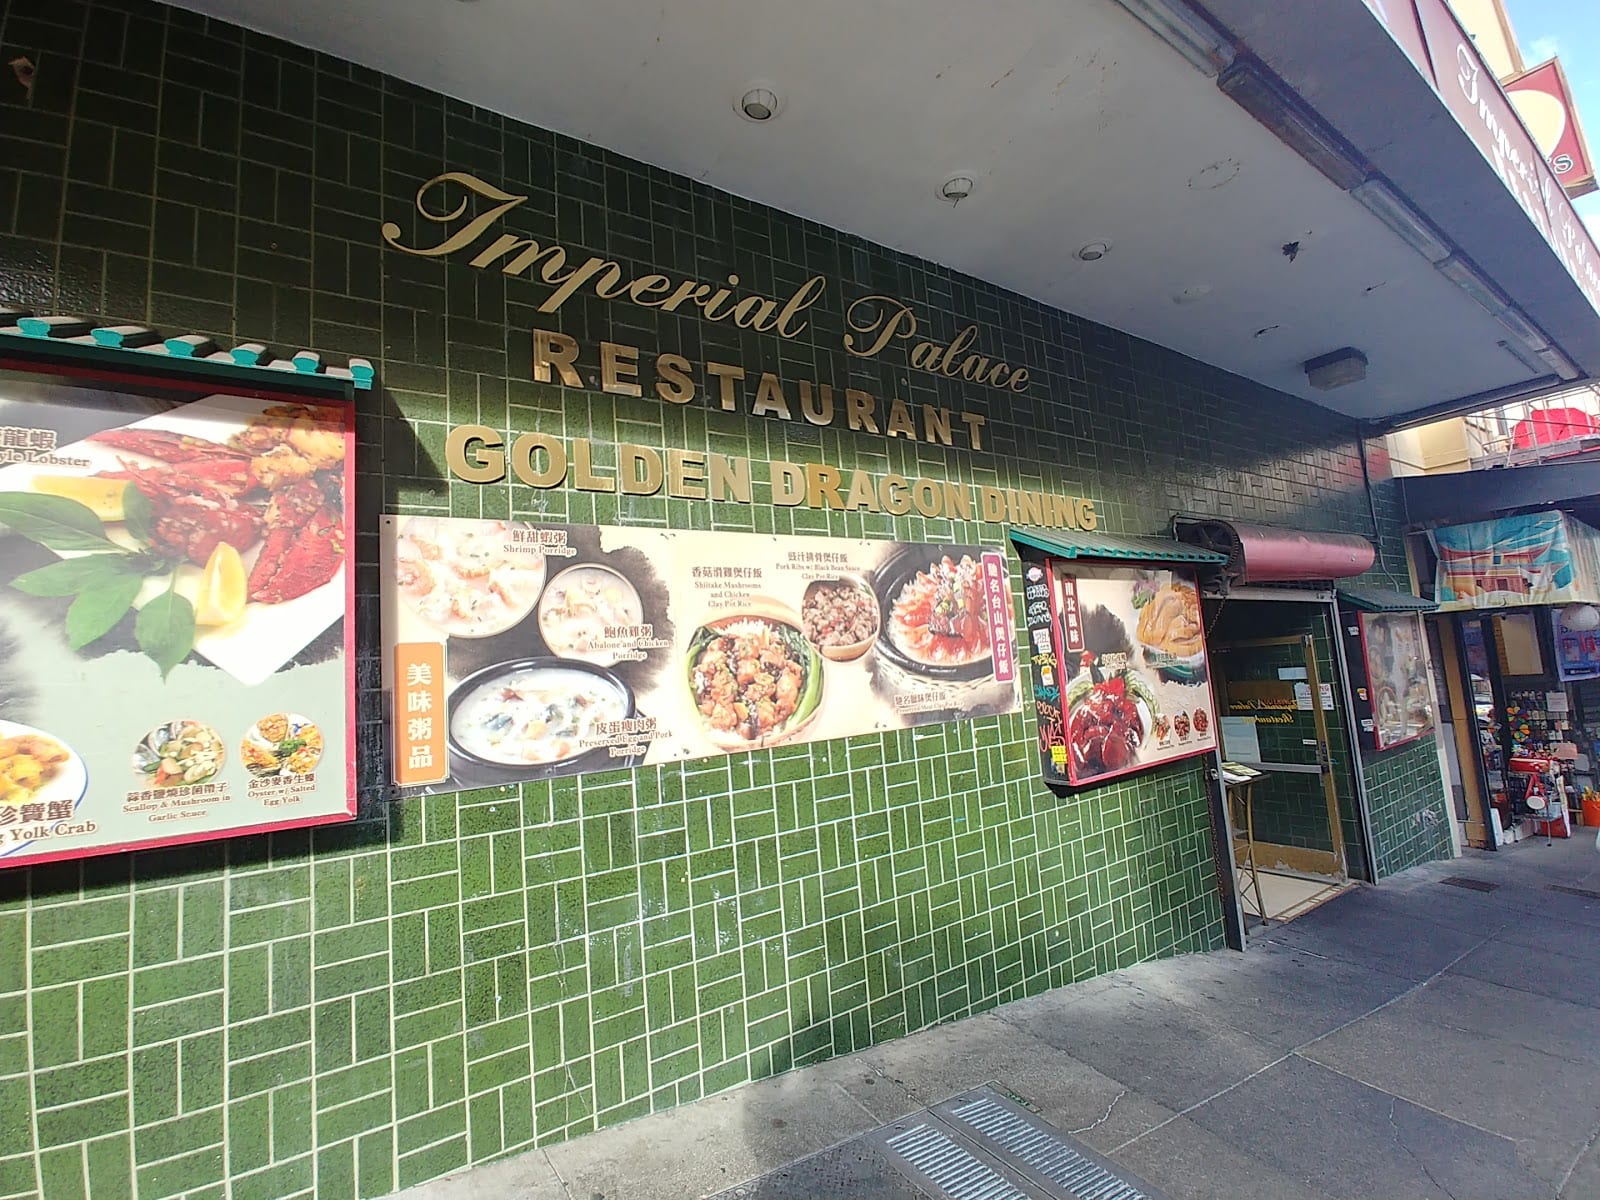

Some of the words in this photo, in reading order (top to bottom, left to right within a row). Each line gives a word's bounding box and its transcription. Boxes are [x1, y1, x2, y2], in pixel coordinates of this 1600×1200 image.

[381, 172, 827, 339] Imperial
[844, 295, 1031, 393] Palace
[532, 328, 987, 452] RESTAURANT
[0, 428, 55, 449] 龍蝦
[0, 450, 23, 463] yle
[27, 451, 90, 466] Lobster
[445, 424, 751, 505] GOLDEN
[769, 461, 974, 521] DRAGON
[982, 486, 1098, 531] DINING
[512, 529, 566, 544] 鮮甜蝦粥
[503, 544, 536, 555] Shrimp
[538, 545, 576, 556] Porridge
[694, 581, 722, 589] Shiitake
[708, 600, 723, 609] Clay
[588, 640, 620, 649] Abalone
[622, 640, 637, 648] and
[638, 639, 668, 648] Chicken
[612, 651, 646, 660] Porridge
[407, 662, 433, 769] 美味粥品
[596, 717, 657, 735] 皮蛋瘦肉粥
[579, 735, 620, 748] Preserved
[622, 735, 637, 744] Egg
[639, 732, 653, 741] and
[655, 729, 673, 739] Pork
[610, 746, 645, 756] Porridge
[248, 790, 276, 798] Oyster
[290, 785, 316, 793] Salted
[122, 803, 158, 812] Scallop
[170, 797, 220, 808] Mushroom
[263, 798, 279, 806] Egg
[282, 796, 301, 804] Yolk
[148, 811, 178, 822] Garlic
[180, 809, 207, 818] Sauce
[10, 826, 50, 841] Yolk
[55, 821, 96, 836] Crab
